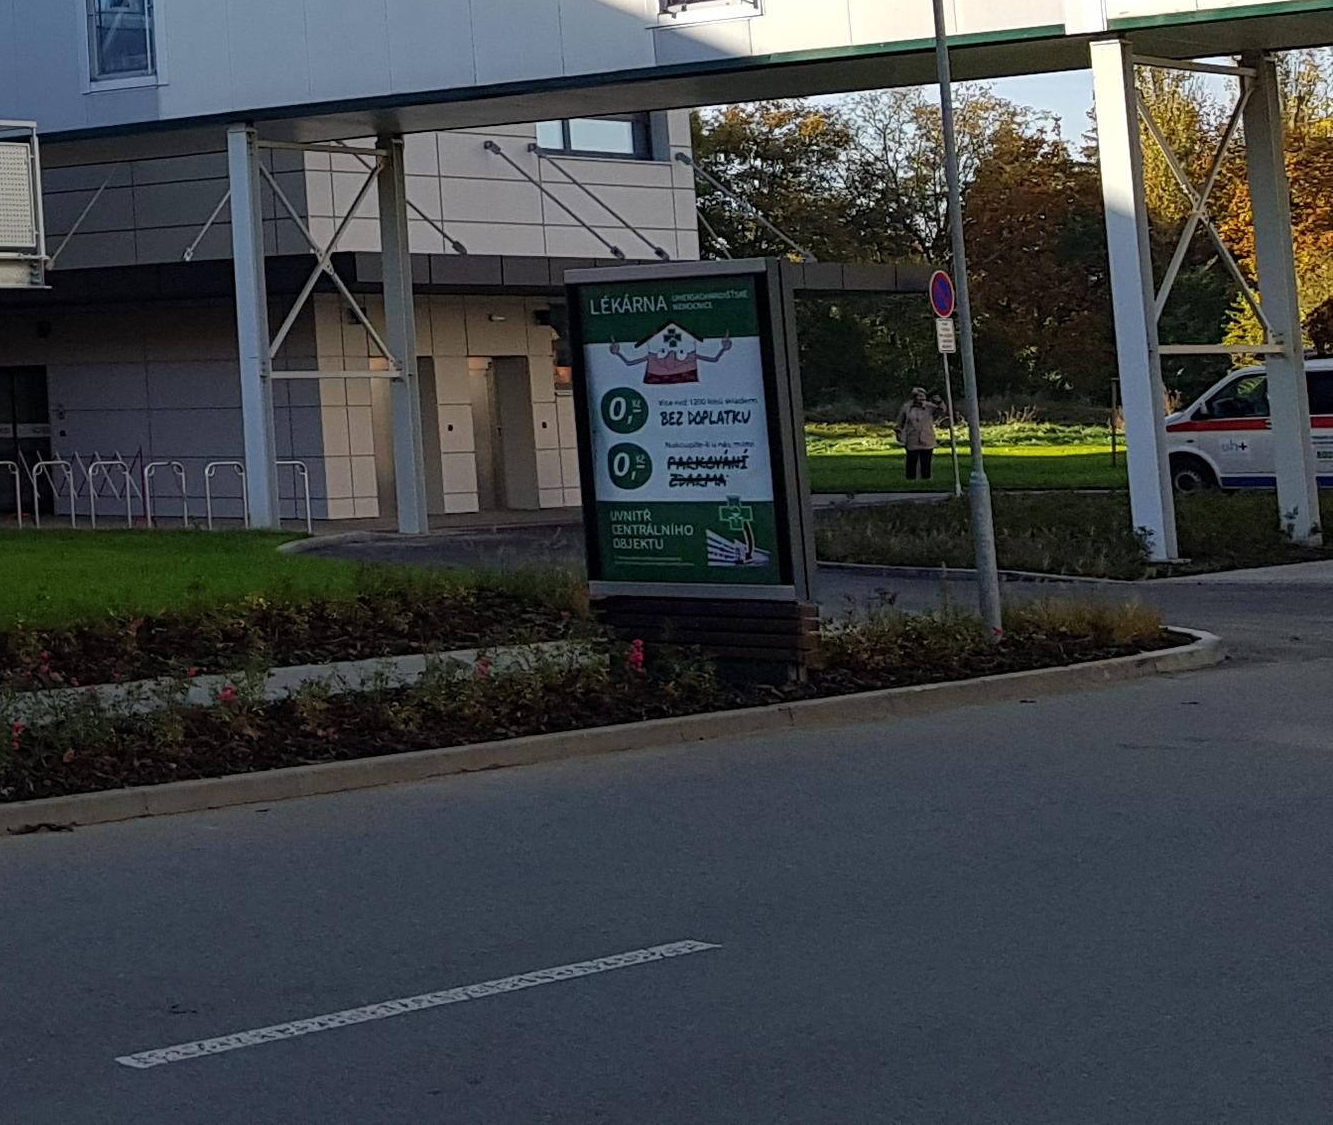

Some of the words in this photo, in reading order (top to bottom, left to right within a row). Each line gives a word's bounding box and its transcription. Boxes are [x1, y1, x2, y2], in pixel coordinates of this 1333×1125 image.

[590, 294, 668, 315] LÉKÁRNA
[660, 410, 684, 426] BEZ
[688, 409, 751, 425] DOPLATKU
[610, 509, 652, 521] UVNITŘ
[612, 523, 694, 536] CENTRÁLNÍHO
[613, 538, 664, 550] OBJEKTU
